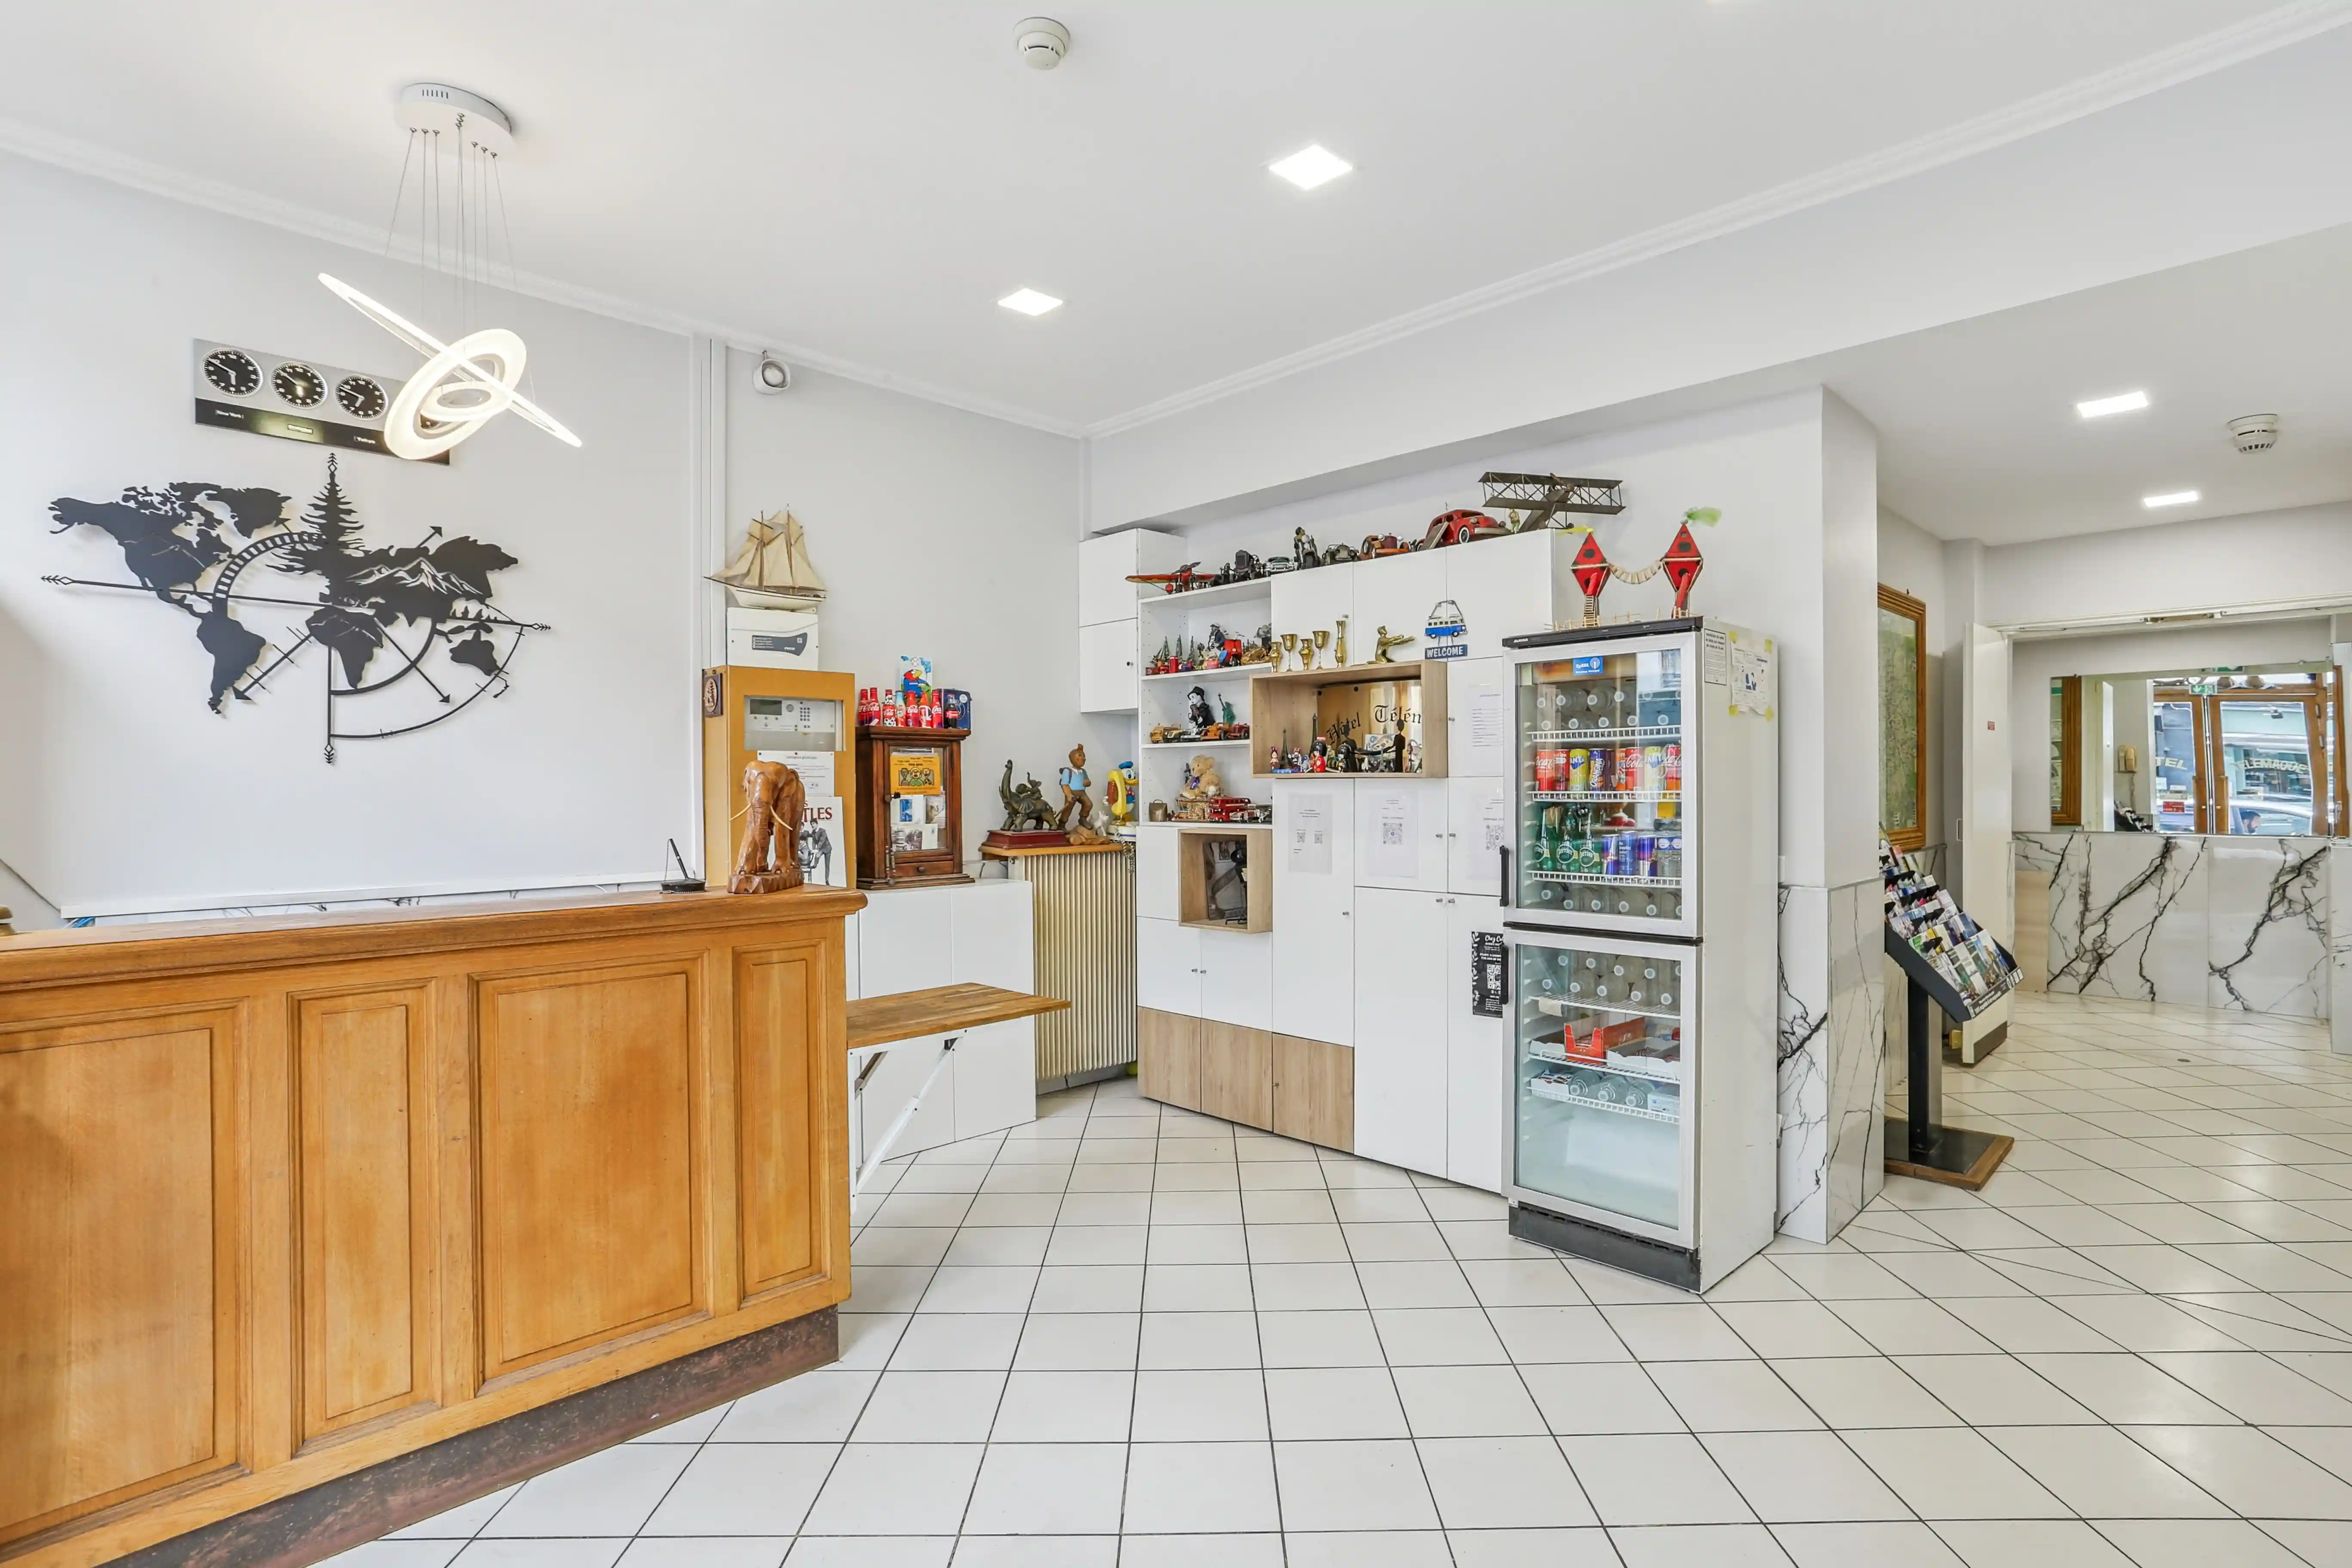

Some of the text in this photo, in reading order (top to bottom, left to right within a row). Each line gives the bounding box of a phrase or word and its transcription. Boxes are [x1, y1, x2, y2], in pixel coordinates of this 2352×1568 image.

[1427, 646, 1464, 658] WELCOME
[2155, 756, 2187, 770] TEL
[803, 807, 833, 822] TLES
[1485, 934, 1496, 943] Chez
